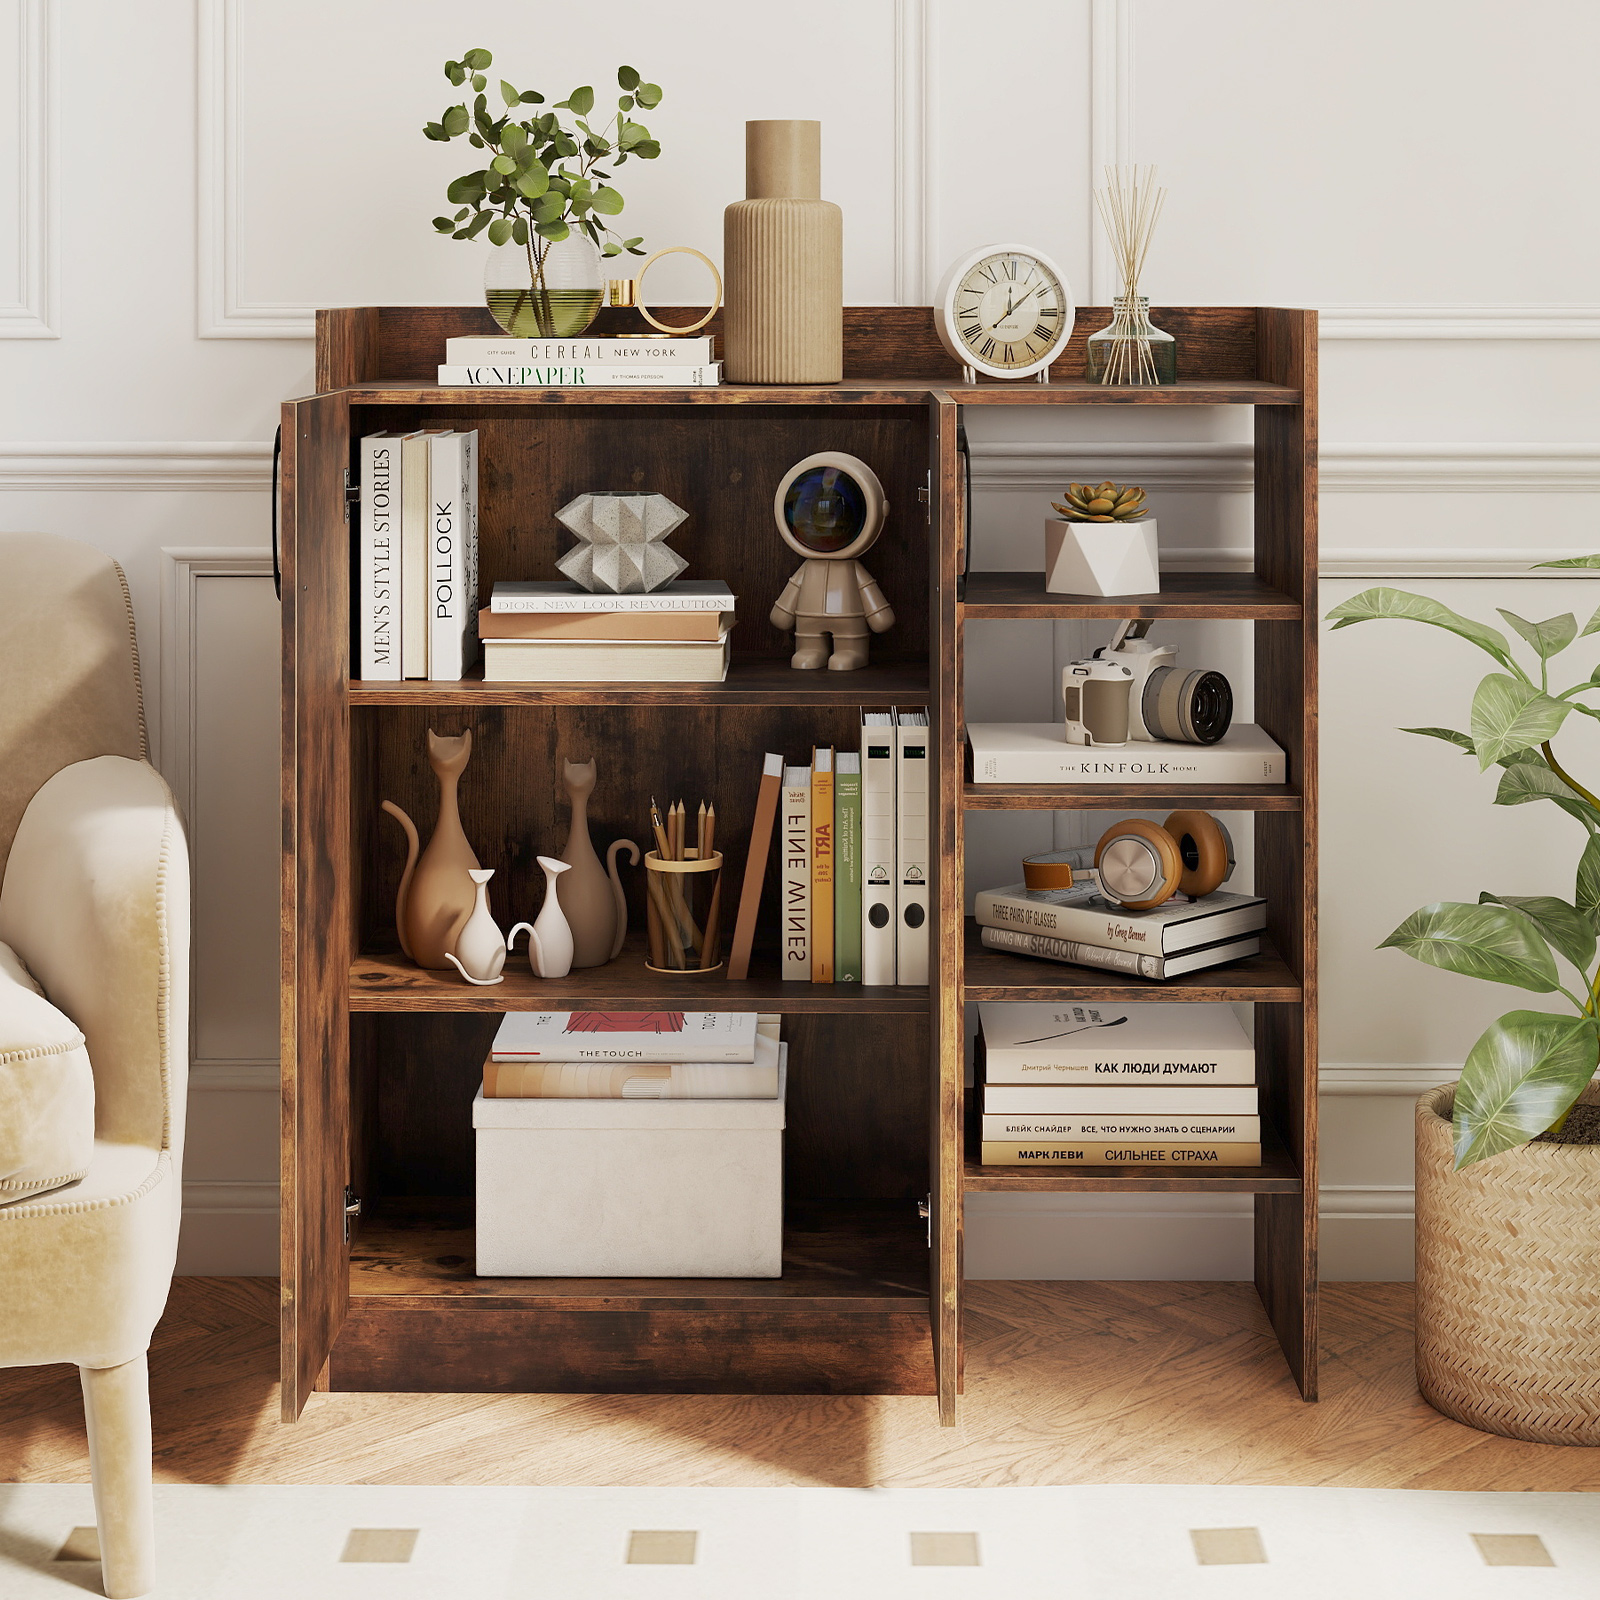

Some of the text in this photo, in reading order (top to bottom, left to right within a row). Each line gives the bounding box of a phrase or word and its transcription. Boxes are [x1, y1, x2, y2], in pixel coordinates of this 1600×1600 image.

[531, 345, 676, 359] CEREAL NEW YORK
[374, 448, 390, 665] MEN'S STYLE STORIES
[437, 501, 453, 618] POLLOCK
[544, 601, 578, 610] NEW
[582, 600, 625, 610] LOOK
[630, 599, 727, 610] REVOLUTION
[1080, 762, 1170, 774] KINFOLK
[992, 904, 1057, 929] THREE PAIRS OF GLASSES
[1107, 922, 1114, 940] by
[1114, 924, 1128, 943] Greg
[989, 929, 1080, 961] LIVING IN A SHADOW
[1021, 1063, 1218, 1075] Дмитрий Чернышев КАК ЛЮДИ ДУМАЮТ
[1006, 1124, 1235, 1135] БЛЕЙК СНАЙДЕР ВСЕ, ЧТО НУЖНО ЗНАТЬ О СЦЕНАРИИ
[1018, 1150, 1218, 1161] МАРК ЛЕВИ СИЛЬНЕЕ СТРАХА
